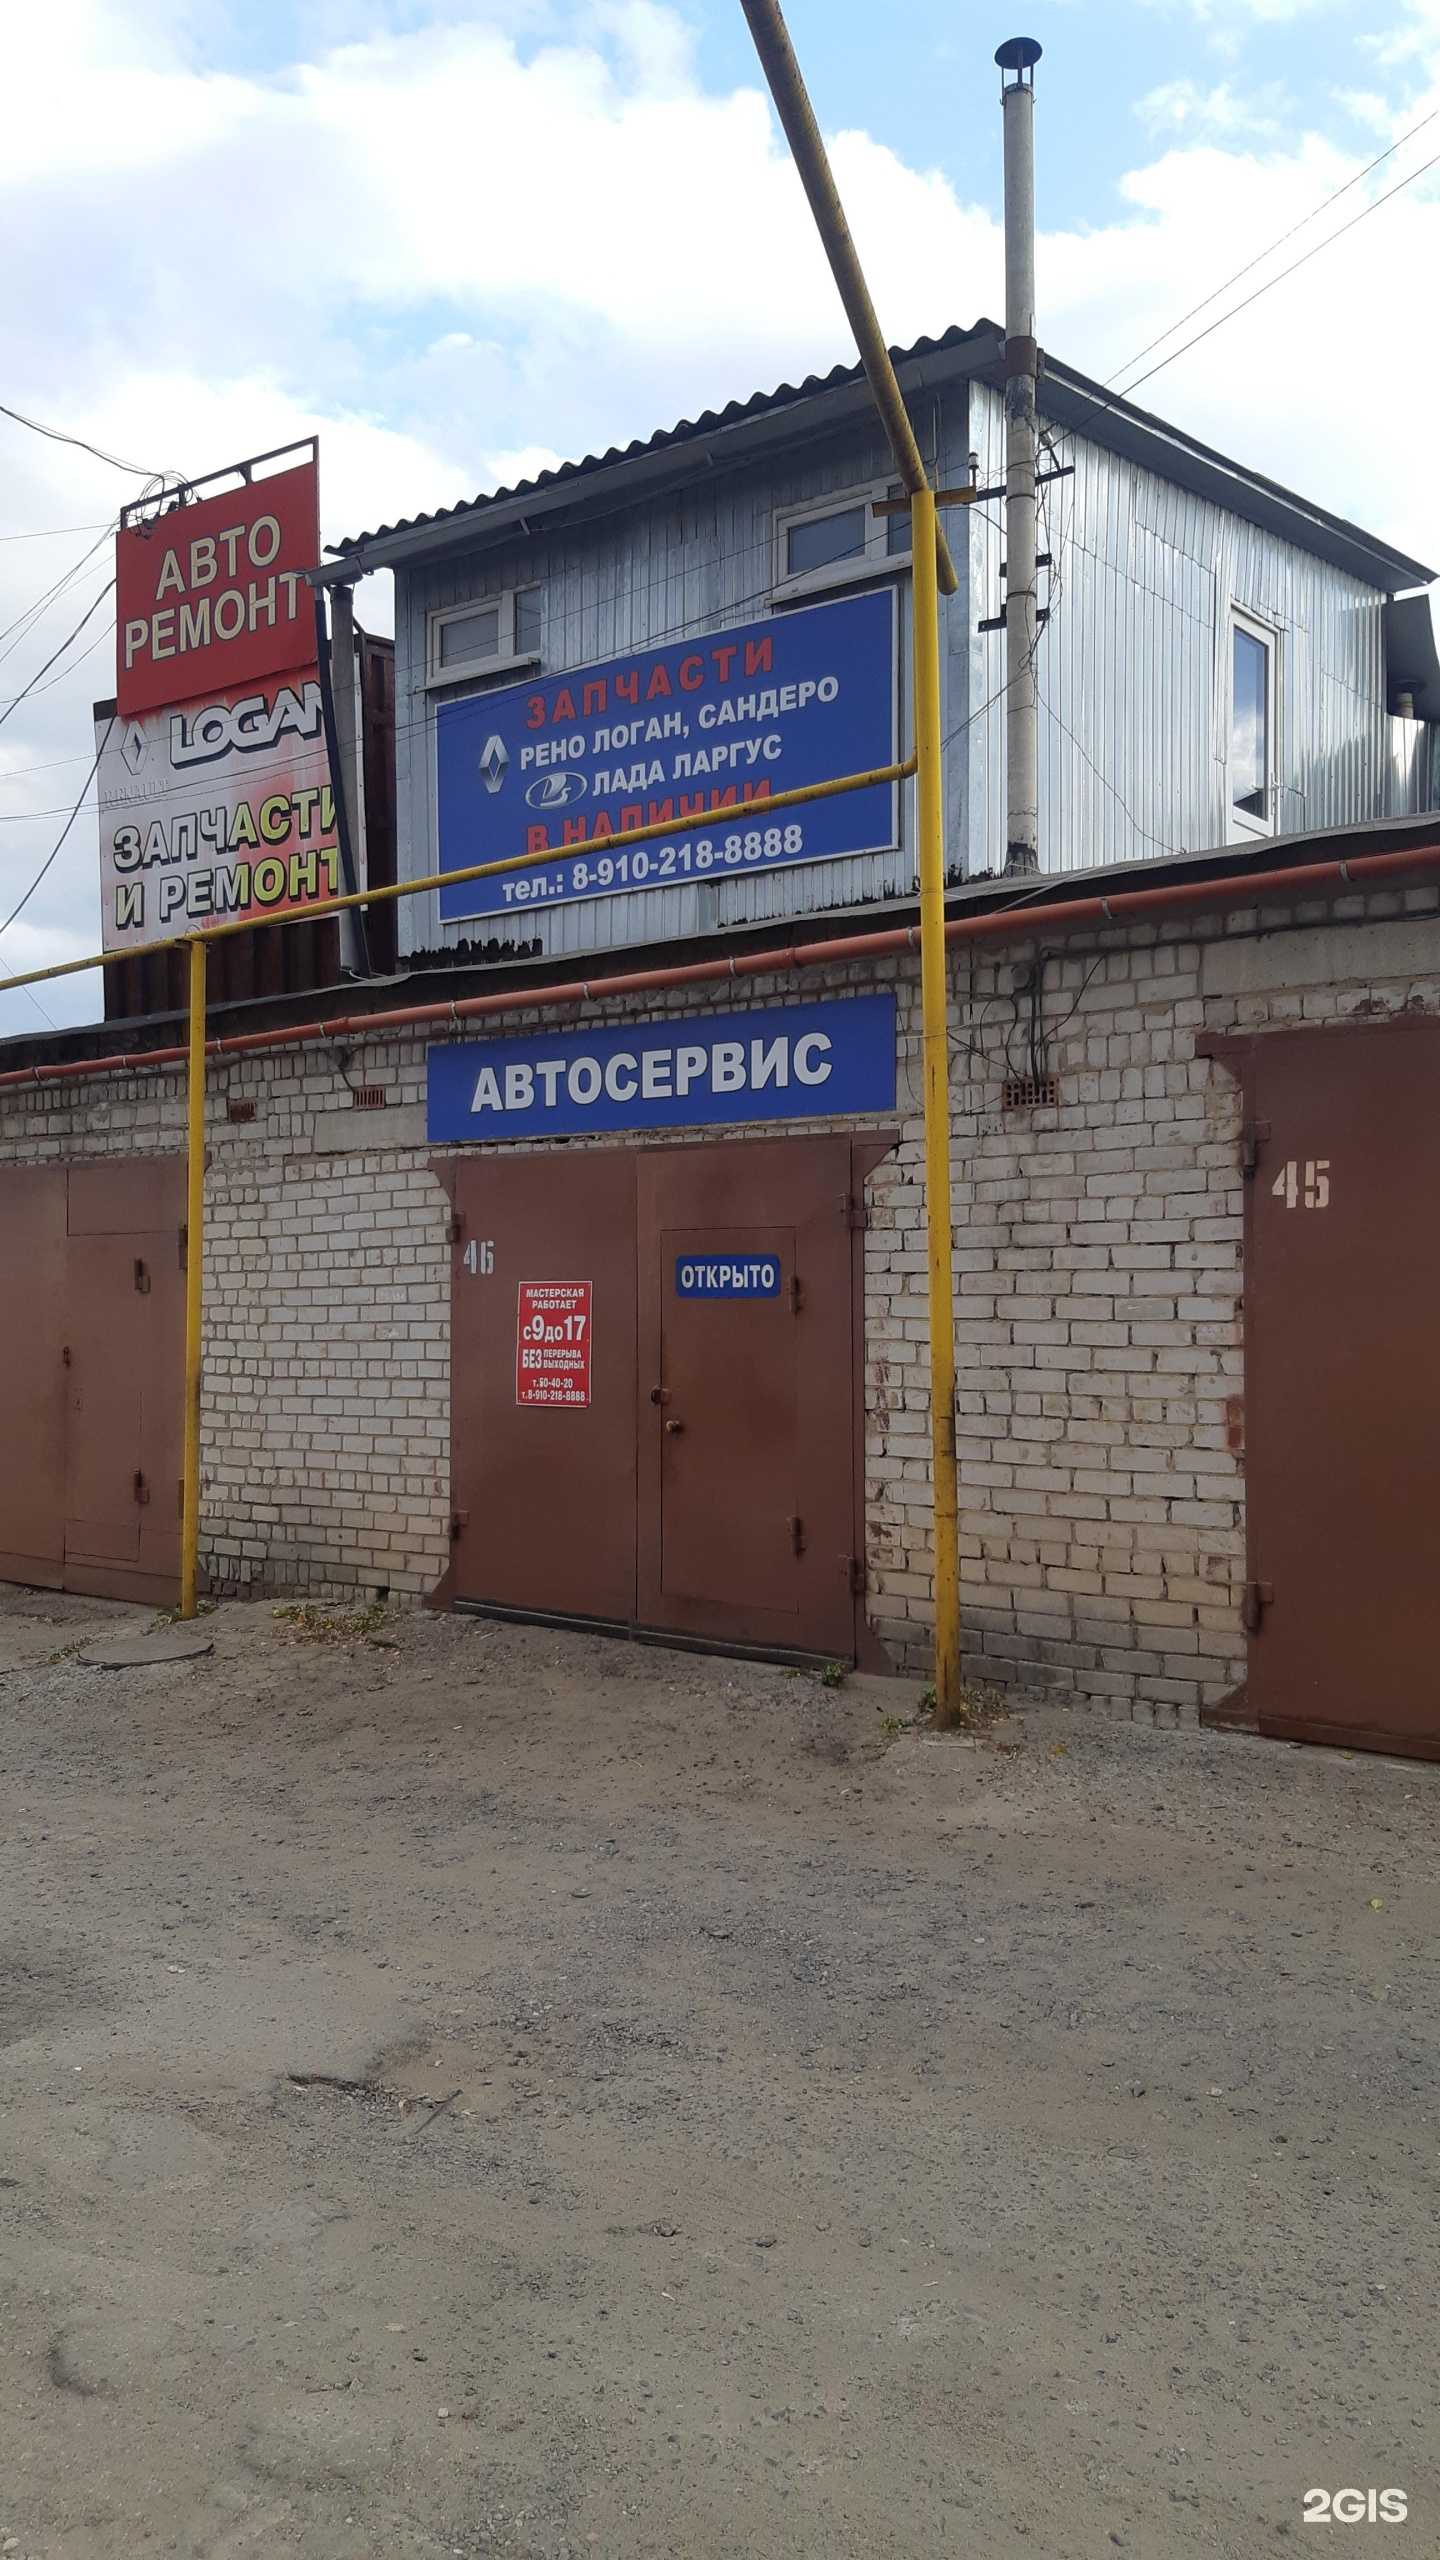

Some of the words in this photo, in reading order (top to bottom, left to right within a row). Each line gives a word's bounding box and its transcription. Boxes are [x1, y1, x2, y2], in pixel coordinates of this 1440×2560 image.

[155, 515, 280, 600] АВТО
[125, 572, 303, 668] РЕМОНТ
[526, 636, 774, 730] ЗАПЧАСТИ
[170, 681, 323, 768] LOGAN
[521, 736, 586, 771] РЕНО
[592, 711, 690, 755] ЛОГАН,
[698, 676, 839, 730] САНДЕРО
[592, 760, 665, 797] ЛАДА
[672, 734, 783, 780] ЛАРГУС
[502, 872, 564, 903] тел.:
[572, 824, 803, 891] 8-910-218-8888
[526, 825, 550, 855] В
[115, 883, 144, 930] И
[159, 847, 338, 928] РЕМОНТ
[470, 1032, 833, 1113] АВТОСЕРВИС
[1271, 1160, 1330, 1209] 45
[463, 1240, 494, 1275] 46
[681, 1264, 775, 1290] ОТКРЫТО
[526, 1288, 585, 1298] МАСТЕРСКАЯ
[532, 1300, 577, 1309] РАБОТАЕТ
[522, 1349, 542, 1369] БЕЗ
[543, 1349, 582, 1359] ПЕРЕРЫВА
[543, 1359, 585, 1370] ВЫХОДНЫХ
